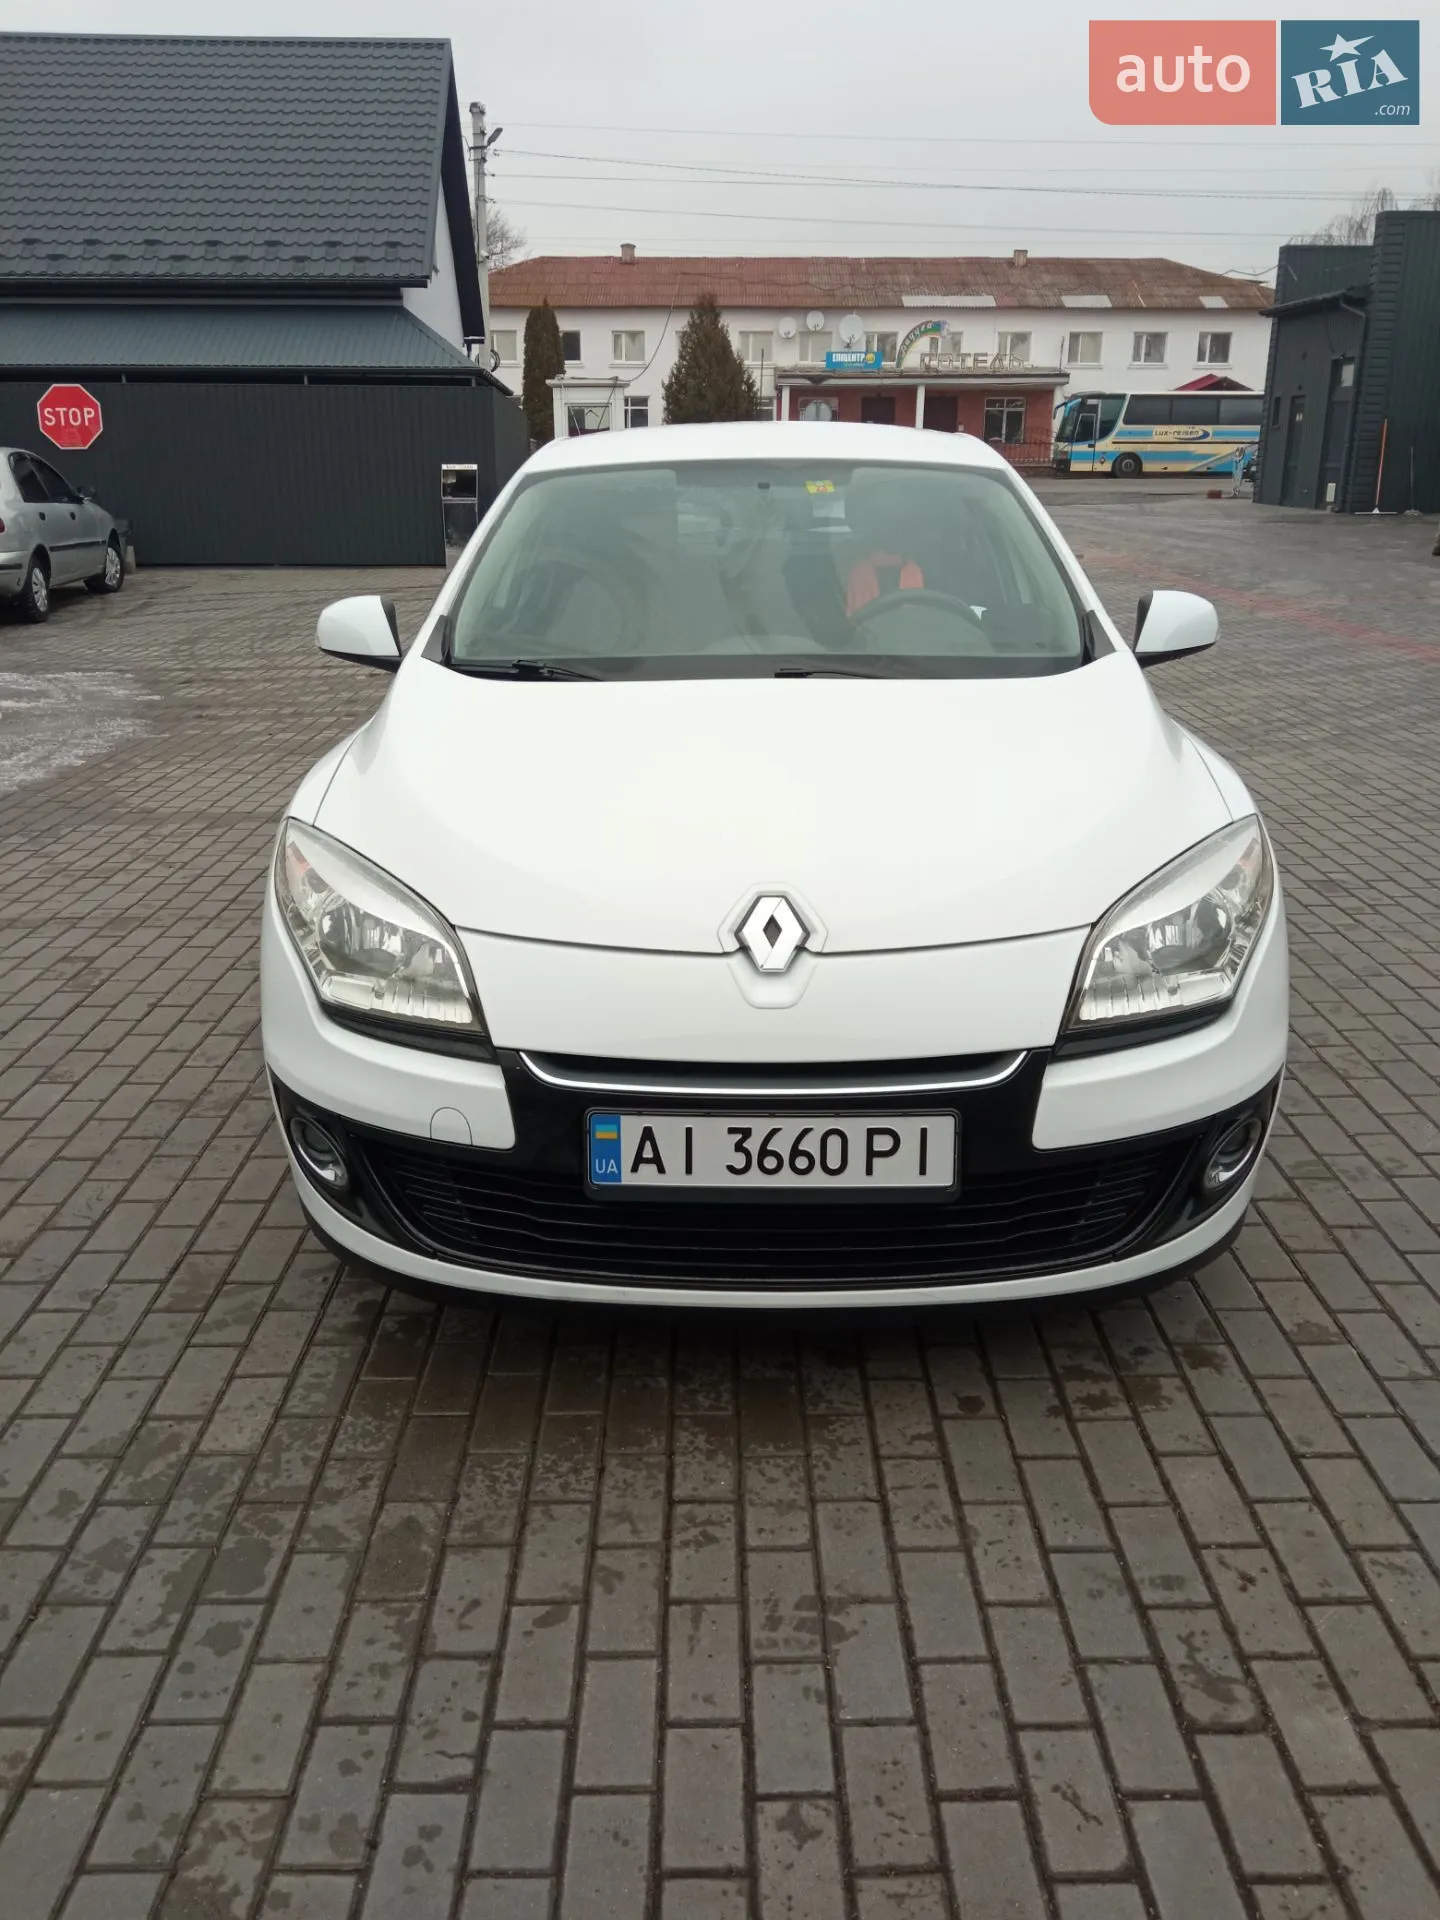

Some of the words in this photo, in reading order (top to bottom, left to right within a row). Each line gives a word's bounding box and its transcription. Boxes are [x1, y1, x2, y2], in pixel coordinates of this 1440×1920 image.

[44, 407, 95, 426] STOP
[630, 1125, 693, 1175] AI
[725, 1127, 849, 1176] 3660
[865, 1127, 928, 1176] PI
[595, 1159, 618, 1175] UA
